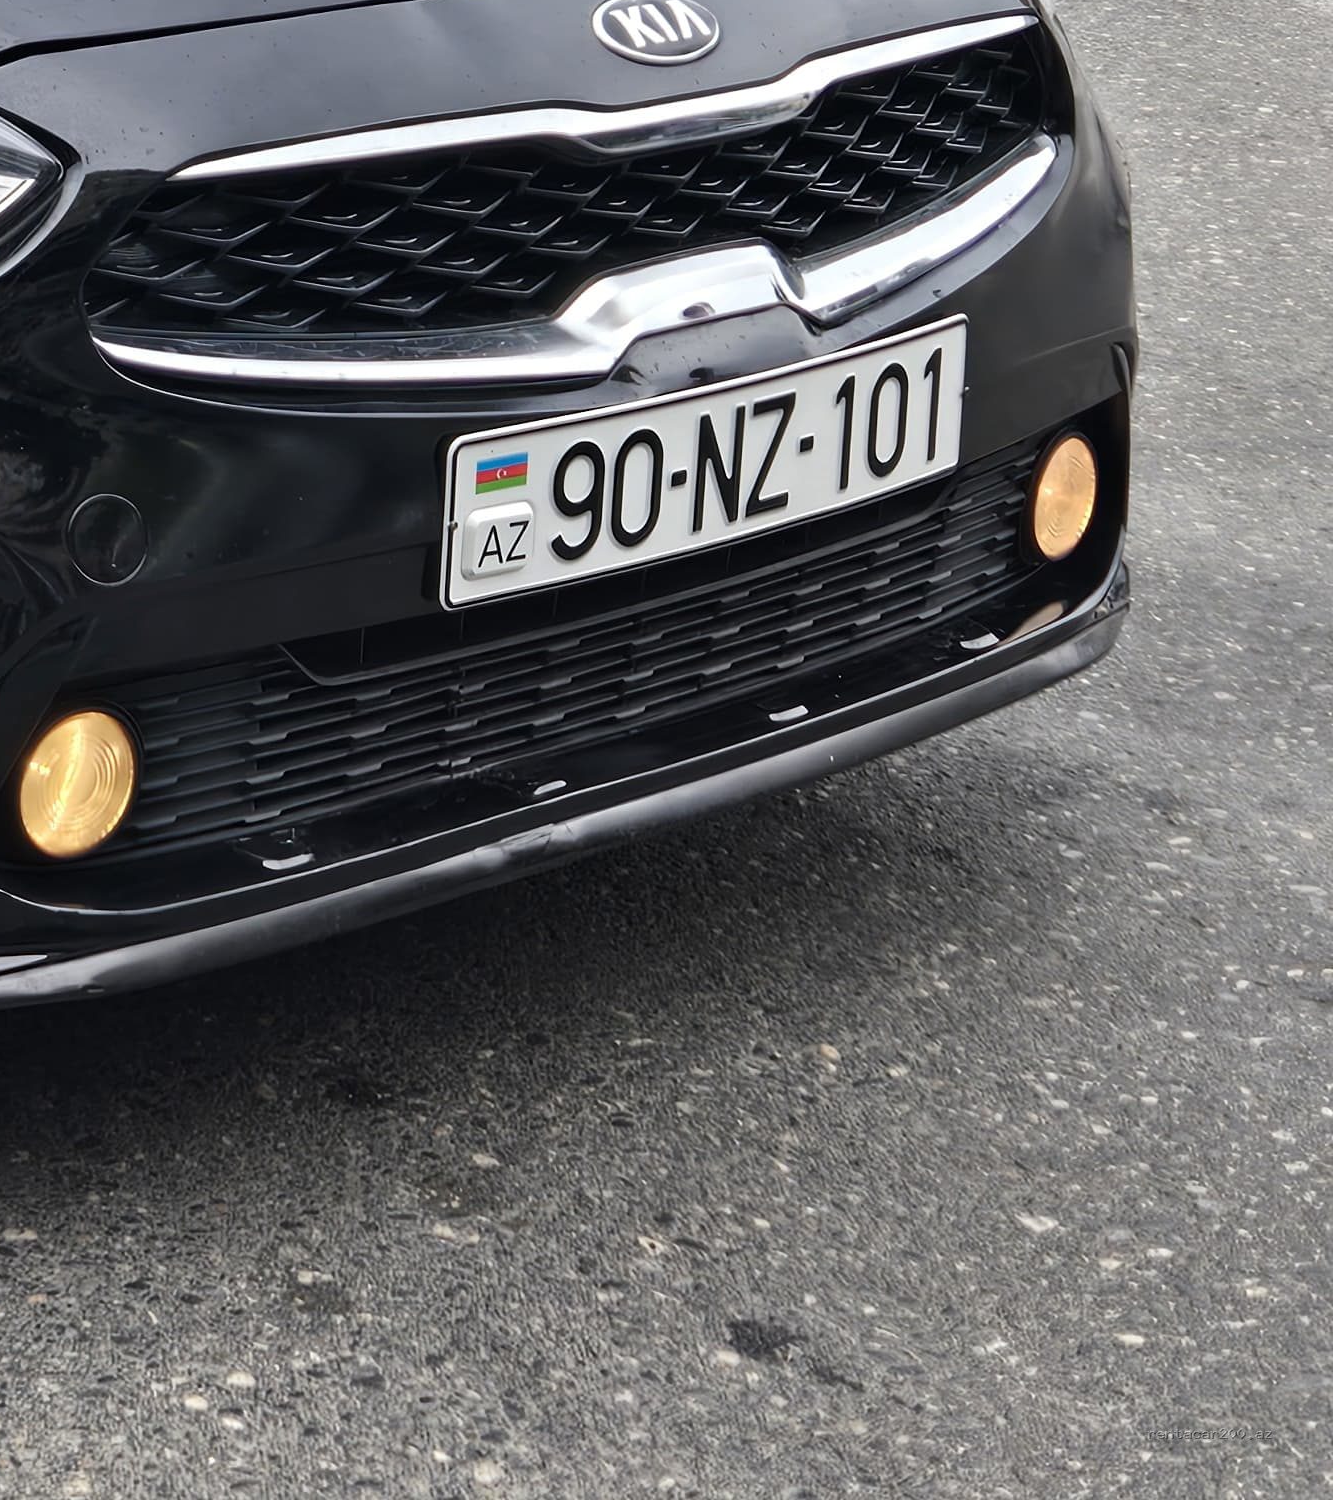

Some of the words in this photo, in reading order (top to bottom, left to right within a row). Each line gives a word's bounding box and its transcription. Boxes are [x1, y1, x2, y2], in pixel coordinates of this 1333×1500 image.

[609, 0, 711, 48] KIA
[550, 347, 942, 562] 90-NZ-101
[478, 520, 529, 569] AZ
